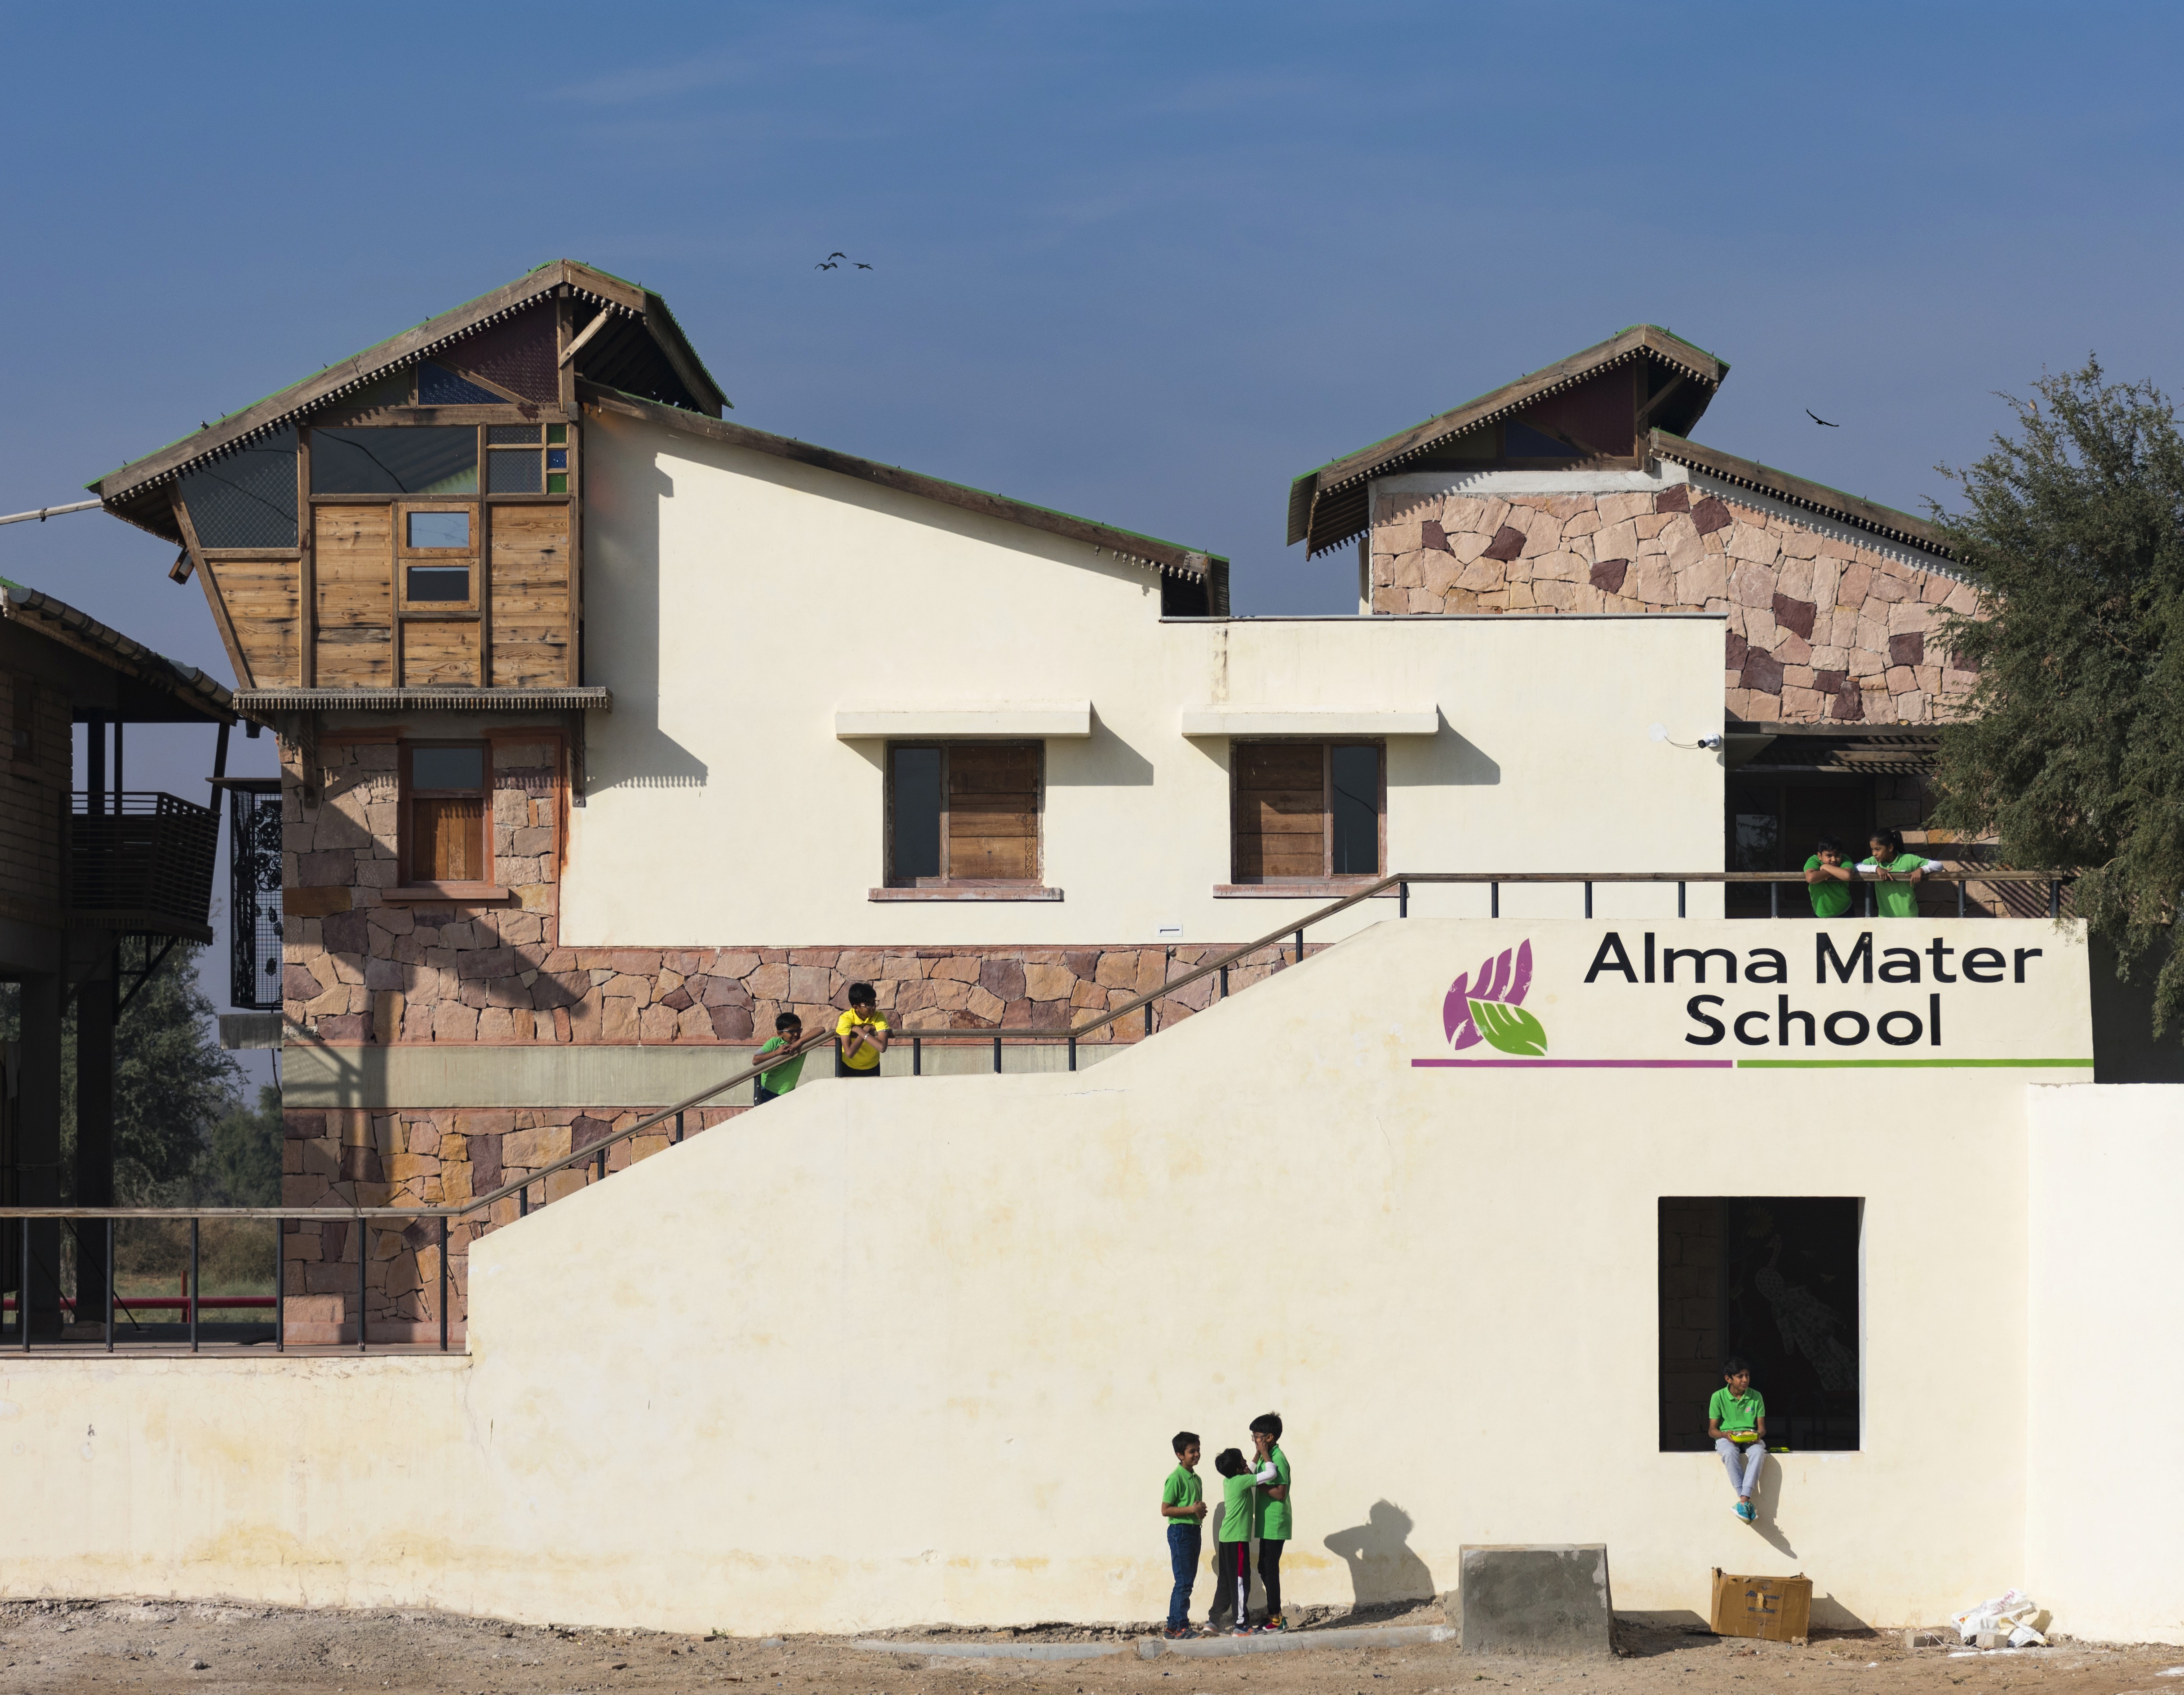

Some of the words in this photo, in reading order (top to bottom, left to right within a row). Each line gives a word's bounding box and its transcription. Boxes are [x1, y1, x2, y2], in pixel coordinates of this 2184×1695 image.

[1584, 932, 1787, 984] Alma
[1816, 932, 2042, 984] Mater
[1685, 993, 1941, 1046] School
